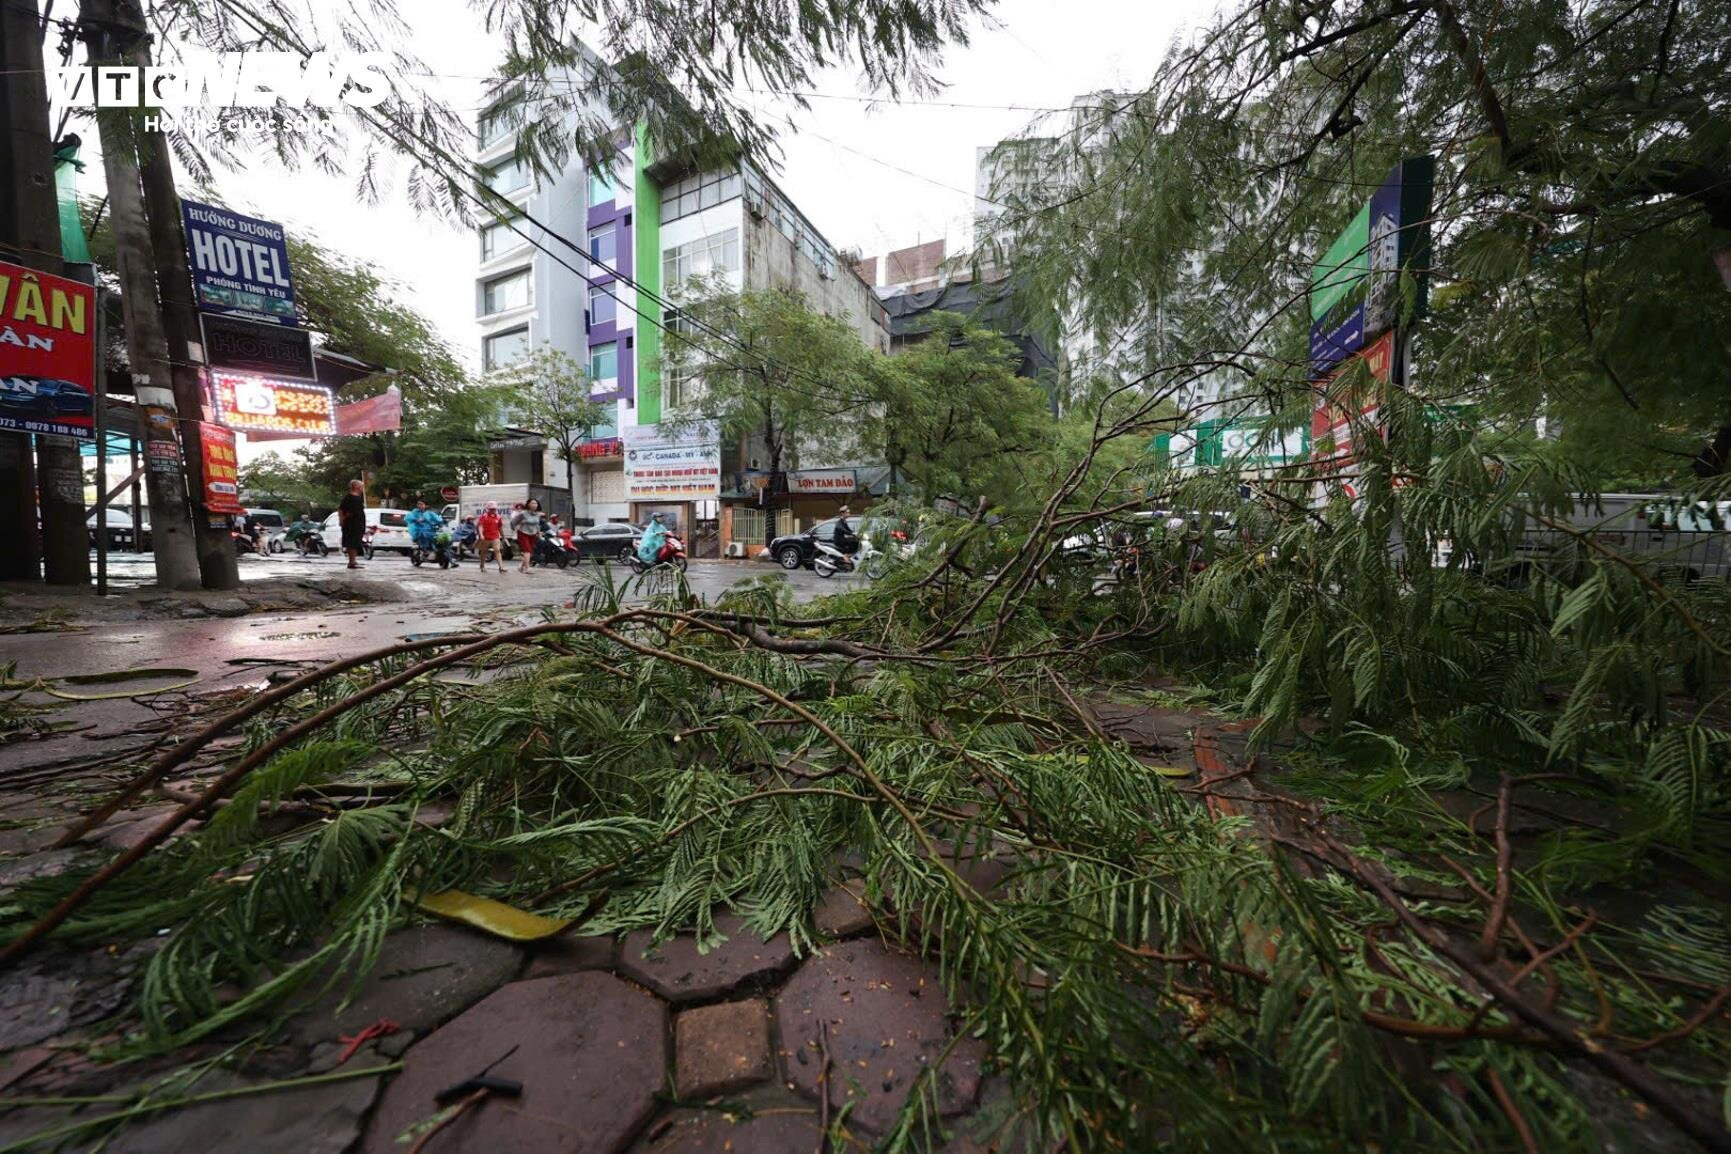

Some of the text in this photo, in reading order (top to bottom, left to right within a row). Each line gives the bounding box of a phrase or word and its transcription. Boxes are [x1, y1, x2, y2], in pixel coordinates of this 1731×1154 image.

[239, 221, 282, 241] DƯƠNG
[191, 228, 290, 288] HOTEL
[244, 283, 266, 295] TÌNH
[268, 287, 286, 299] YÊU
[25, 420, 49, 432] 0978
[816, 478, 833, 487] TAM
